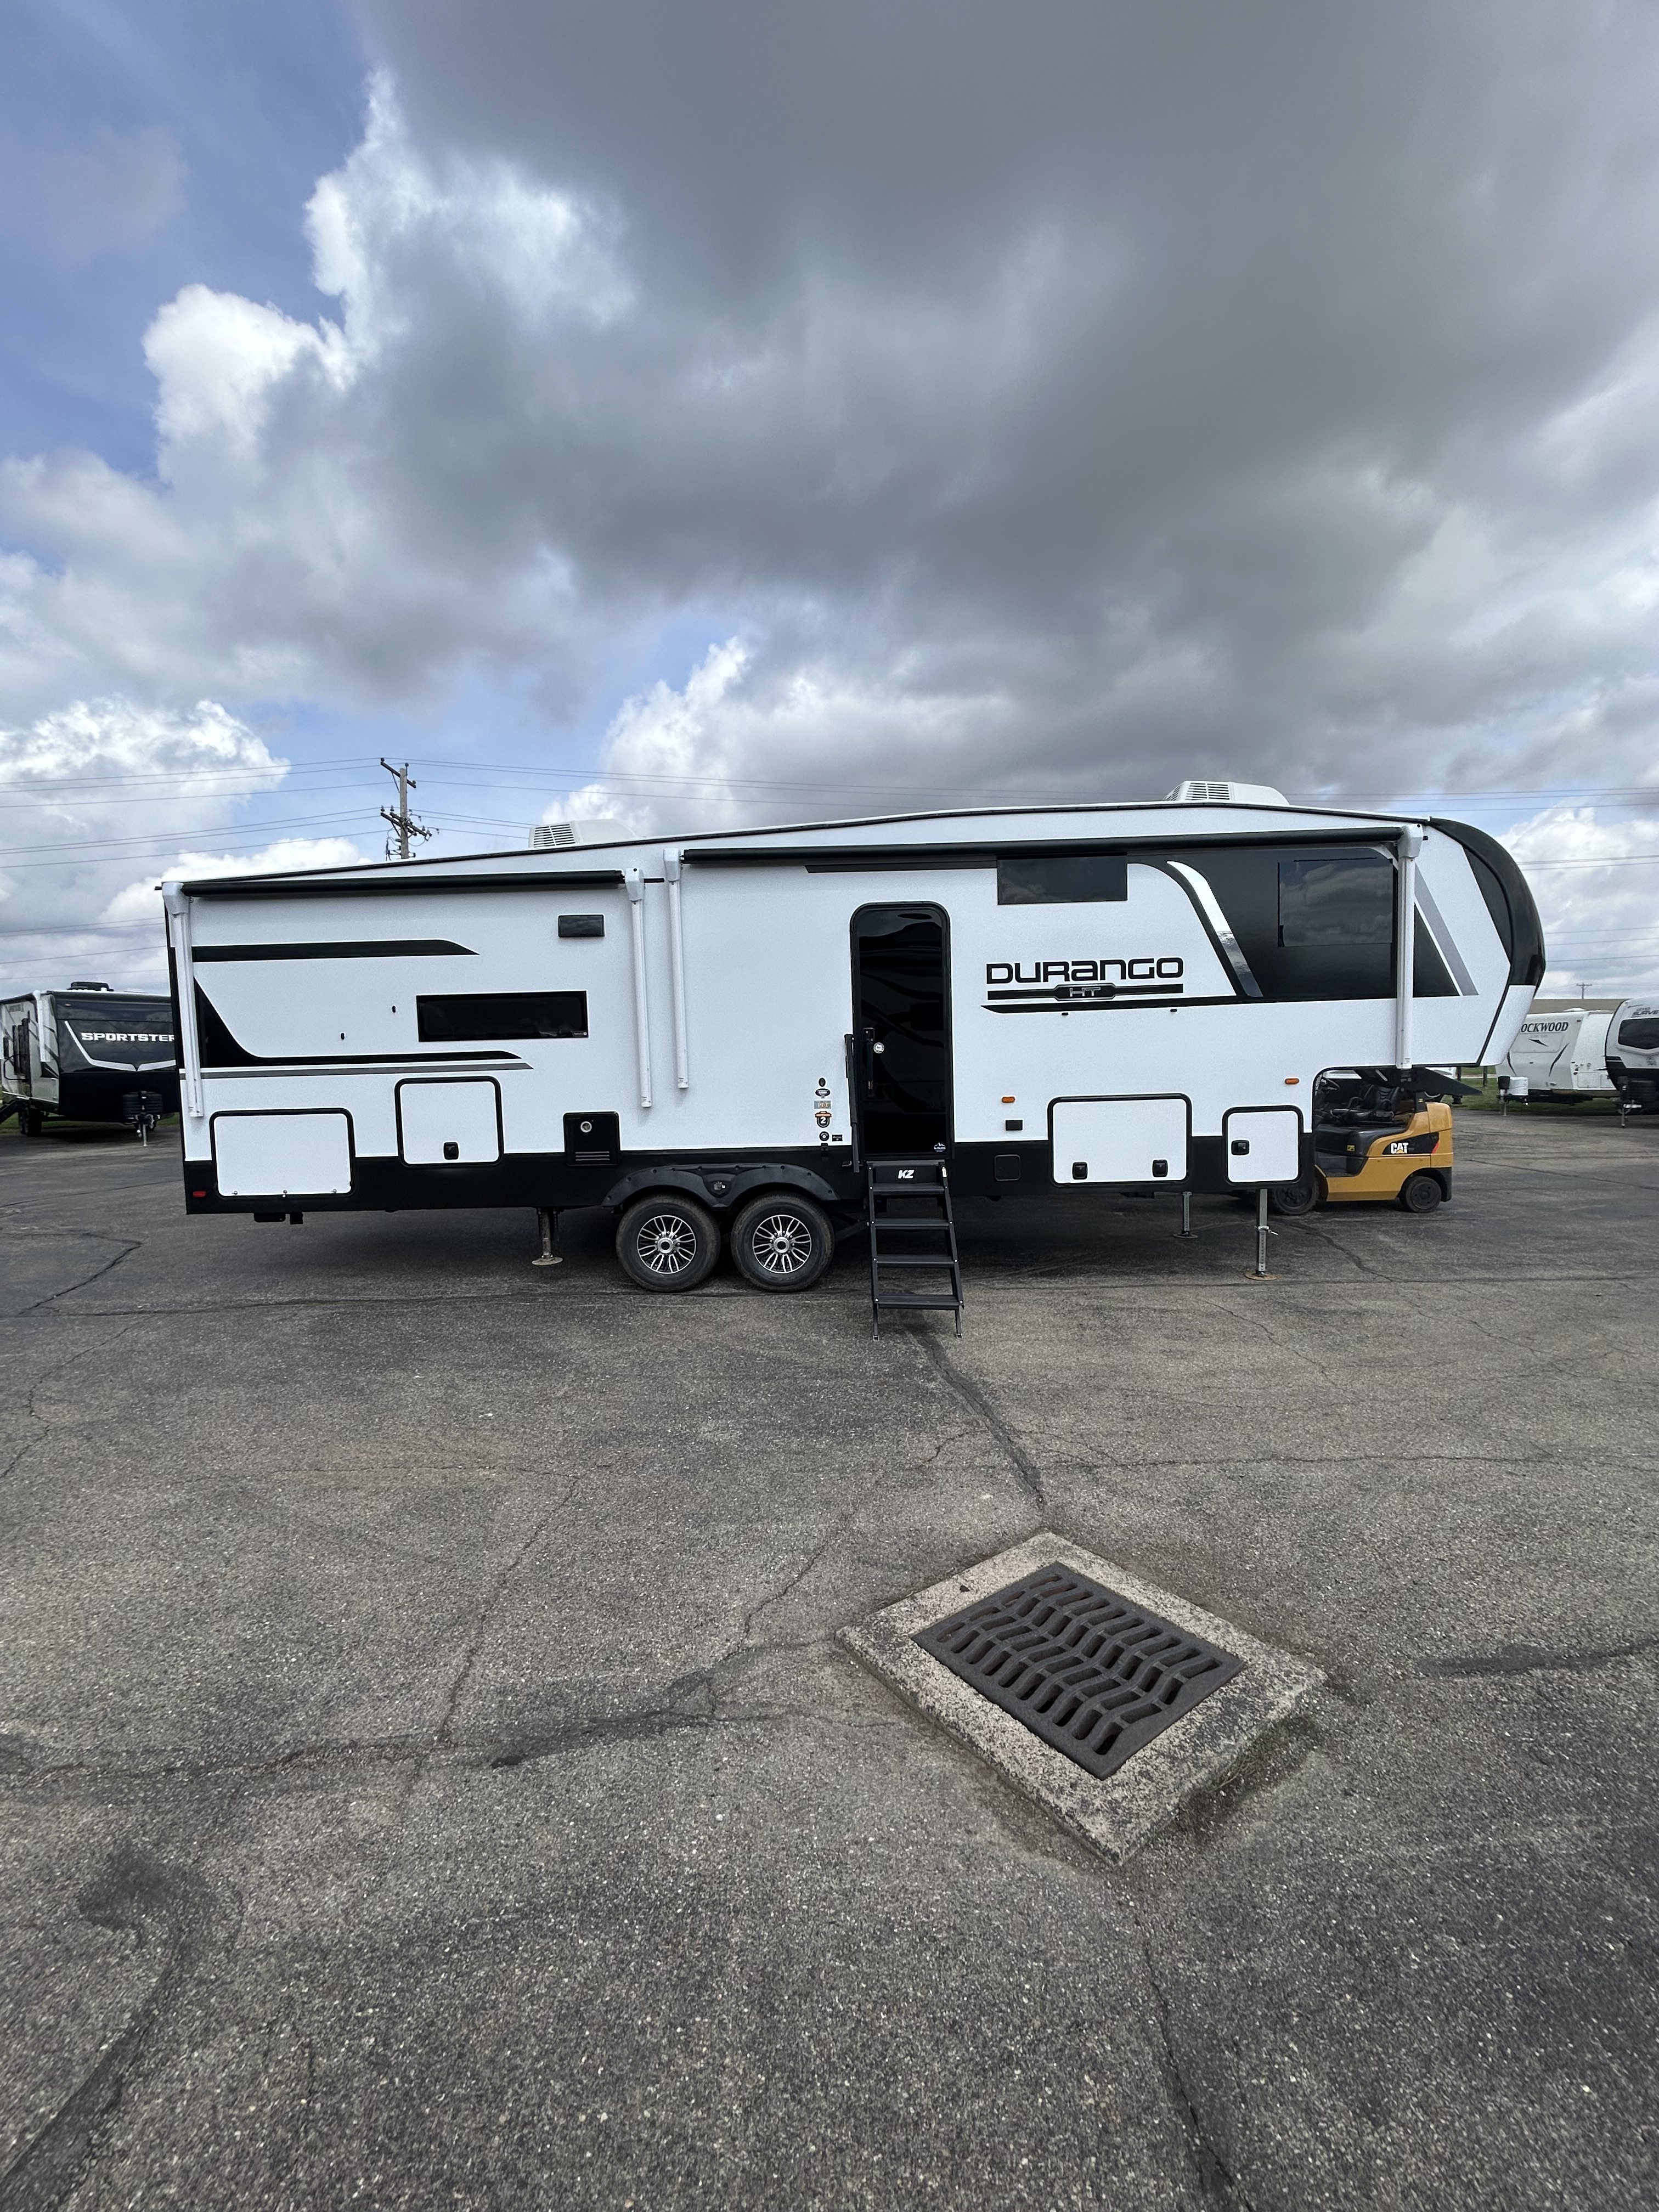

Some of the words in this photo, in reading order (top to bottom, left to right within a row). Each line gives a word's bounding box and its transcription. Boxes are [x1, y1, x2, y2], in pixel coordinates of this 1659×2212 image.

[1069, 986, 1101, 997] HT
[1521, 1022, 1569, 1032] OCKWOOD
[820, 1116, 826, 1124] 2
[1390, 1142, 1409, 1154] CAT
[898, 1170, 915, 1179] KZ
